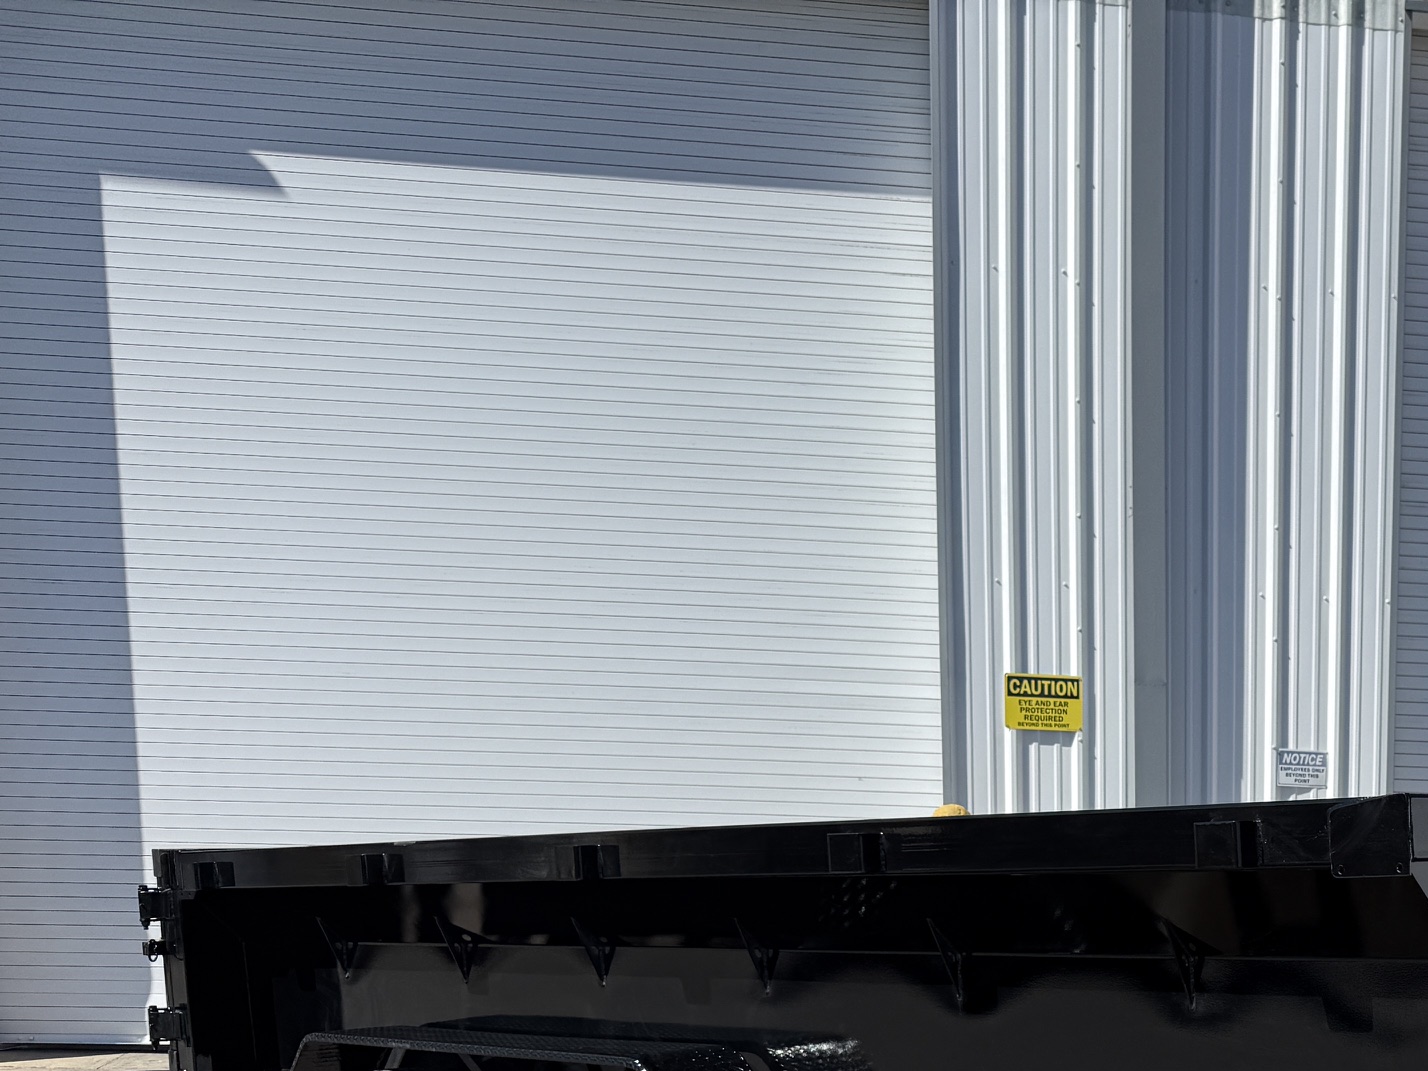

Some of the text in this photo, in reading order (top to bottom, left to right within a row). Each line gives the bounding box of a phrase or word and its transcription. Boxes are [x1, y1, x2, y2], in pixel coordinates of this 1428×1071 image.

[1009, 679, 1078, 697] CAUTION
[1020, 707, 1068, 715] PROTECTION
[1024, 714, 1064, 722] REQUIRED
[1282, 753, 1324, 766] NOTICE
